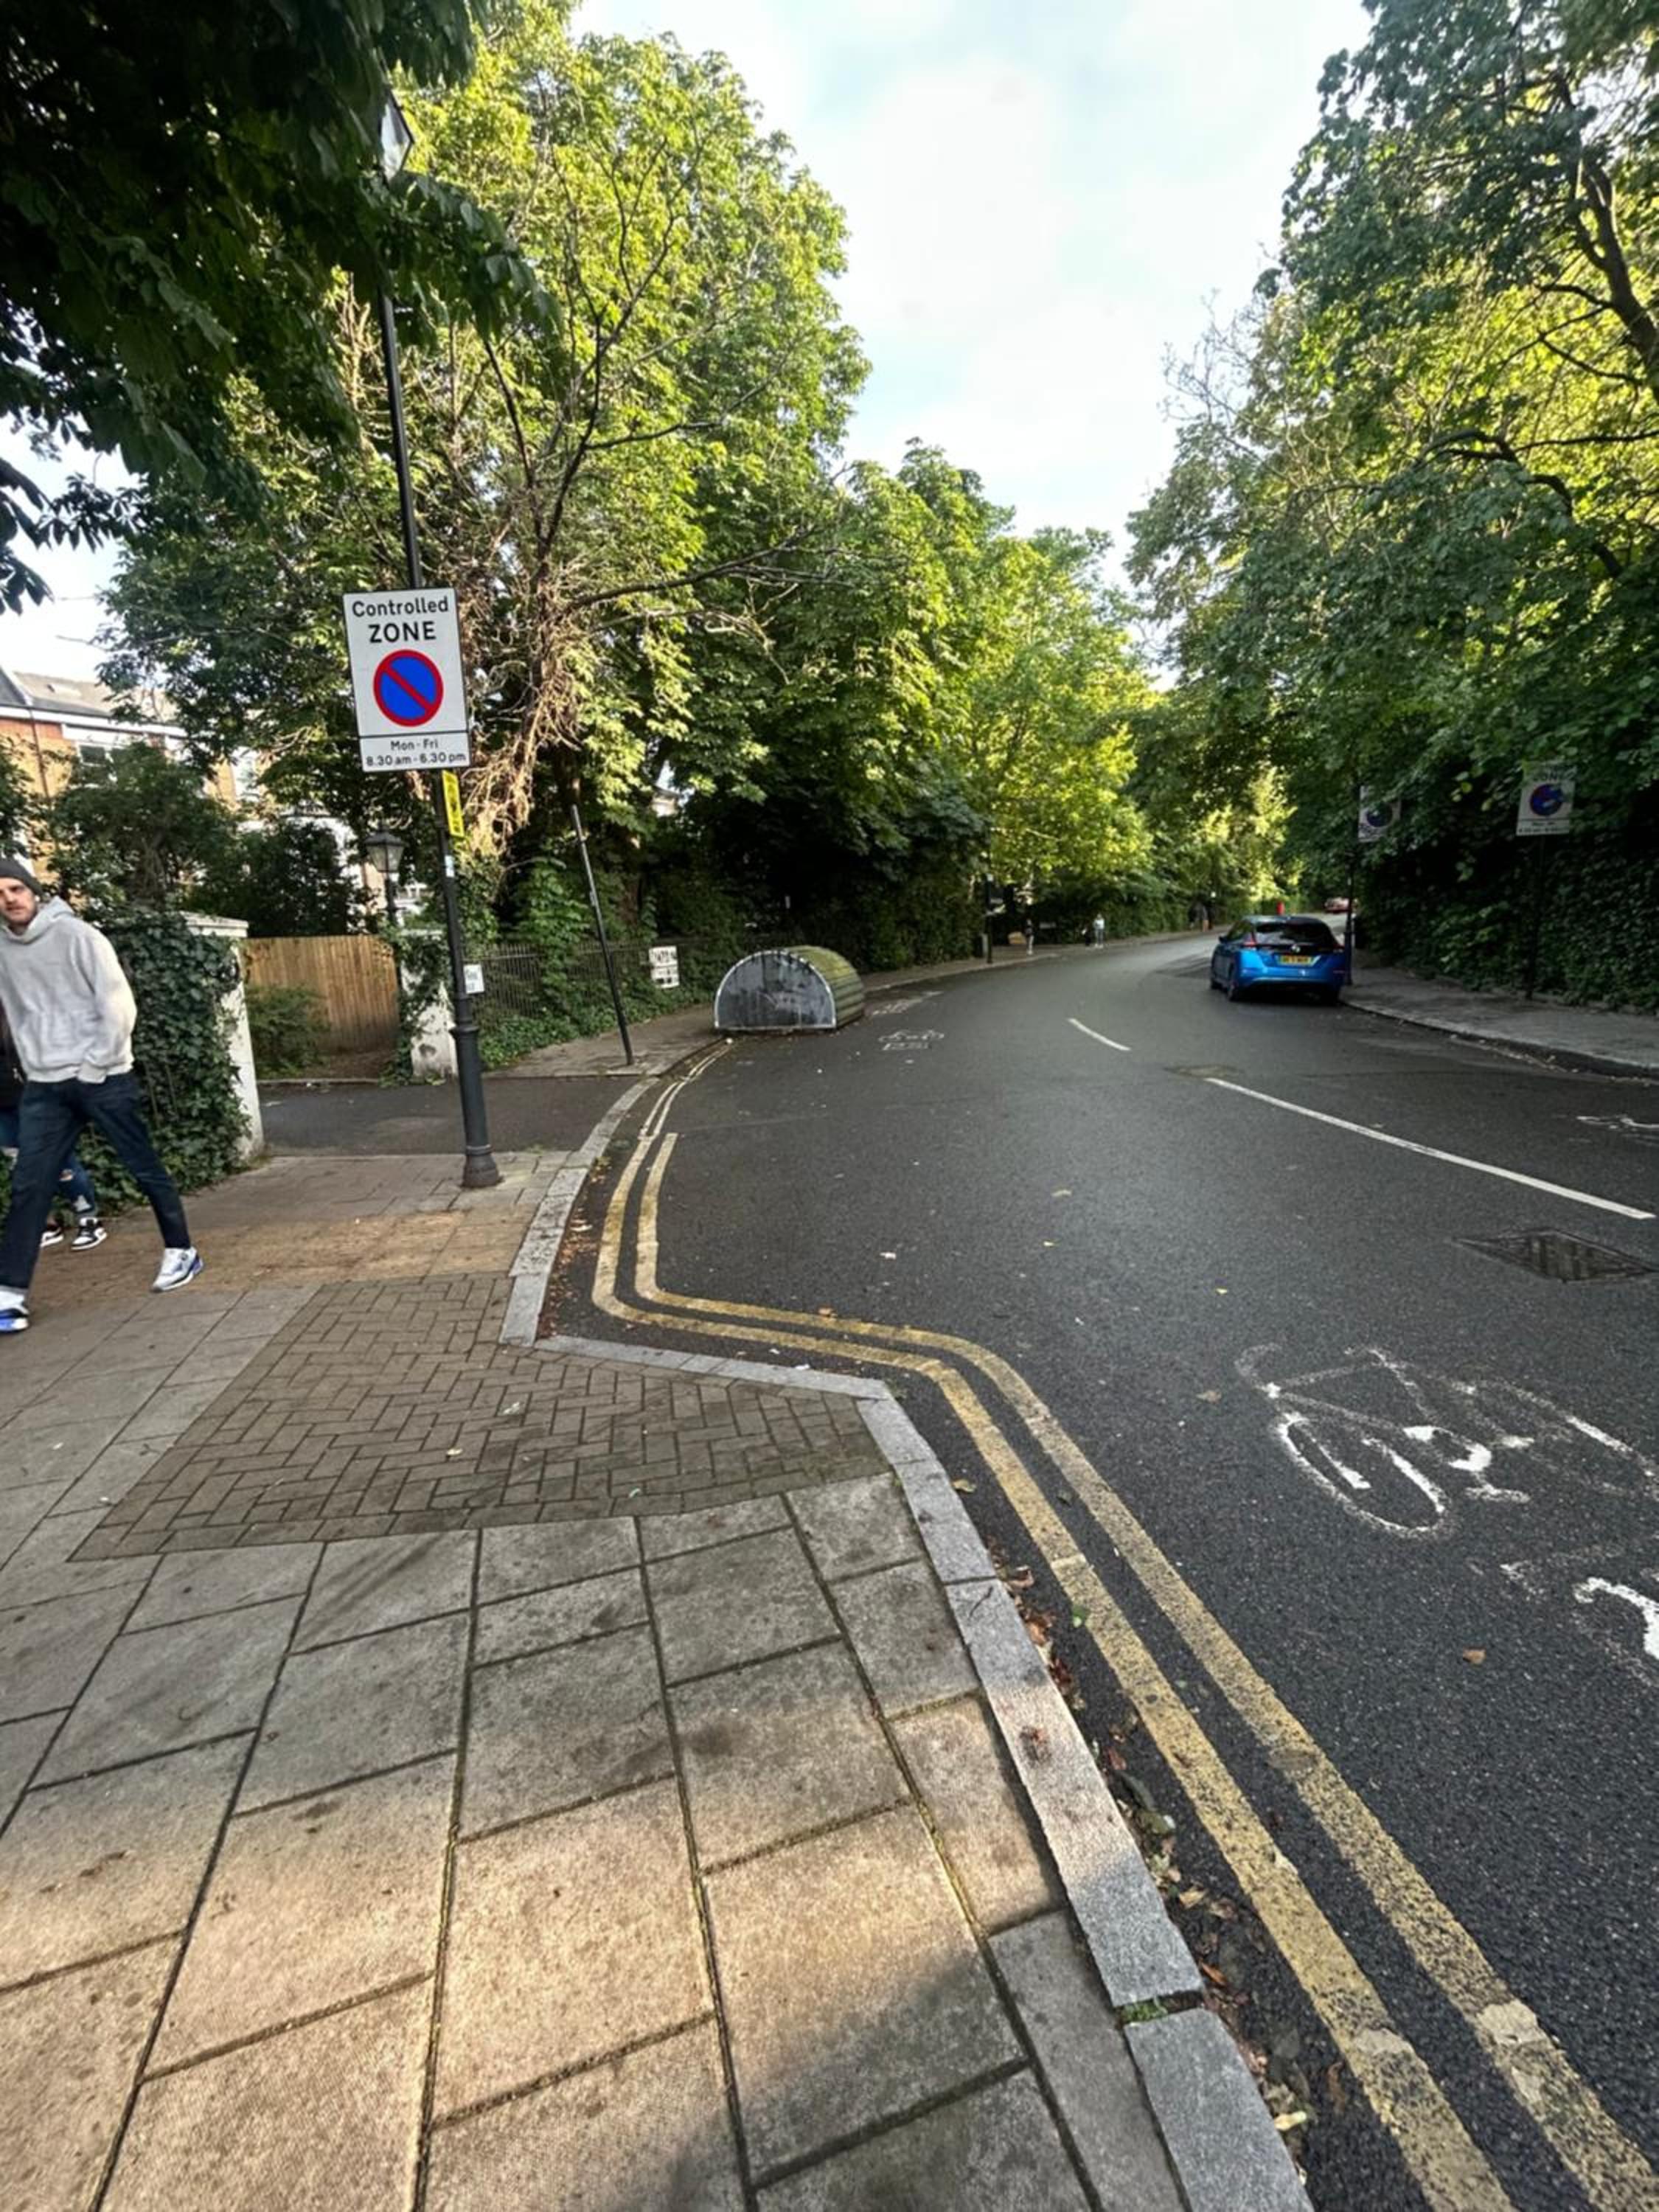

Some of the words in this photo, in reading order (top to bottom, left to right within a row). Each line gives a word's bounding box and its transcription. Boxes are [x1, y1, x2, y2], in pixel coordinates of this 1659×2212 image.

[352, 596, 449, 618] Controlled
[368, 621, 437, 644] ZONE
[390, 740, 415, 751] Mon
[422, 738, 439, 749] Fri
